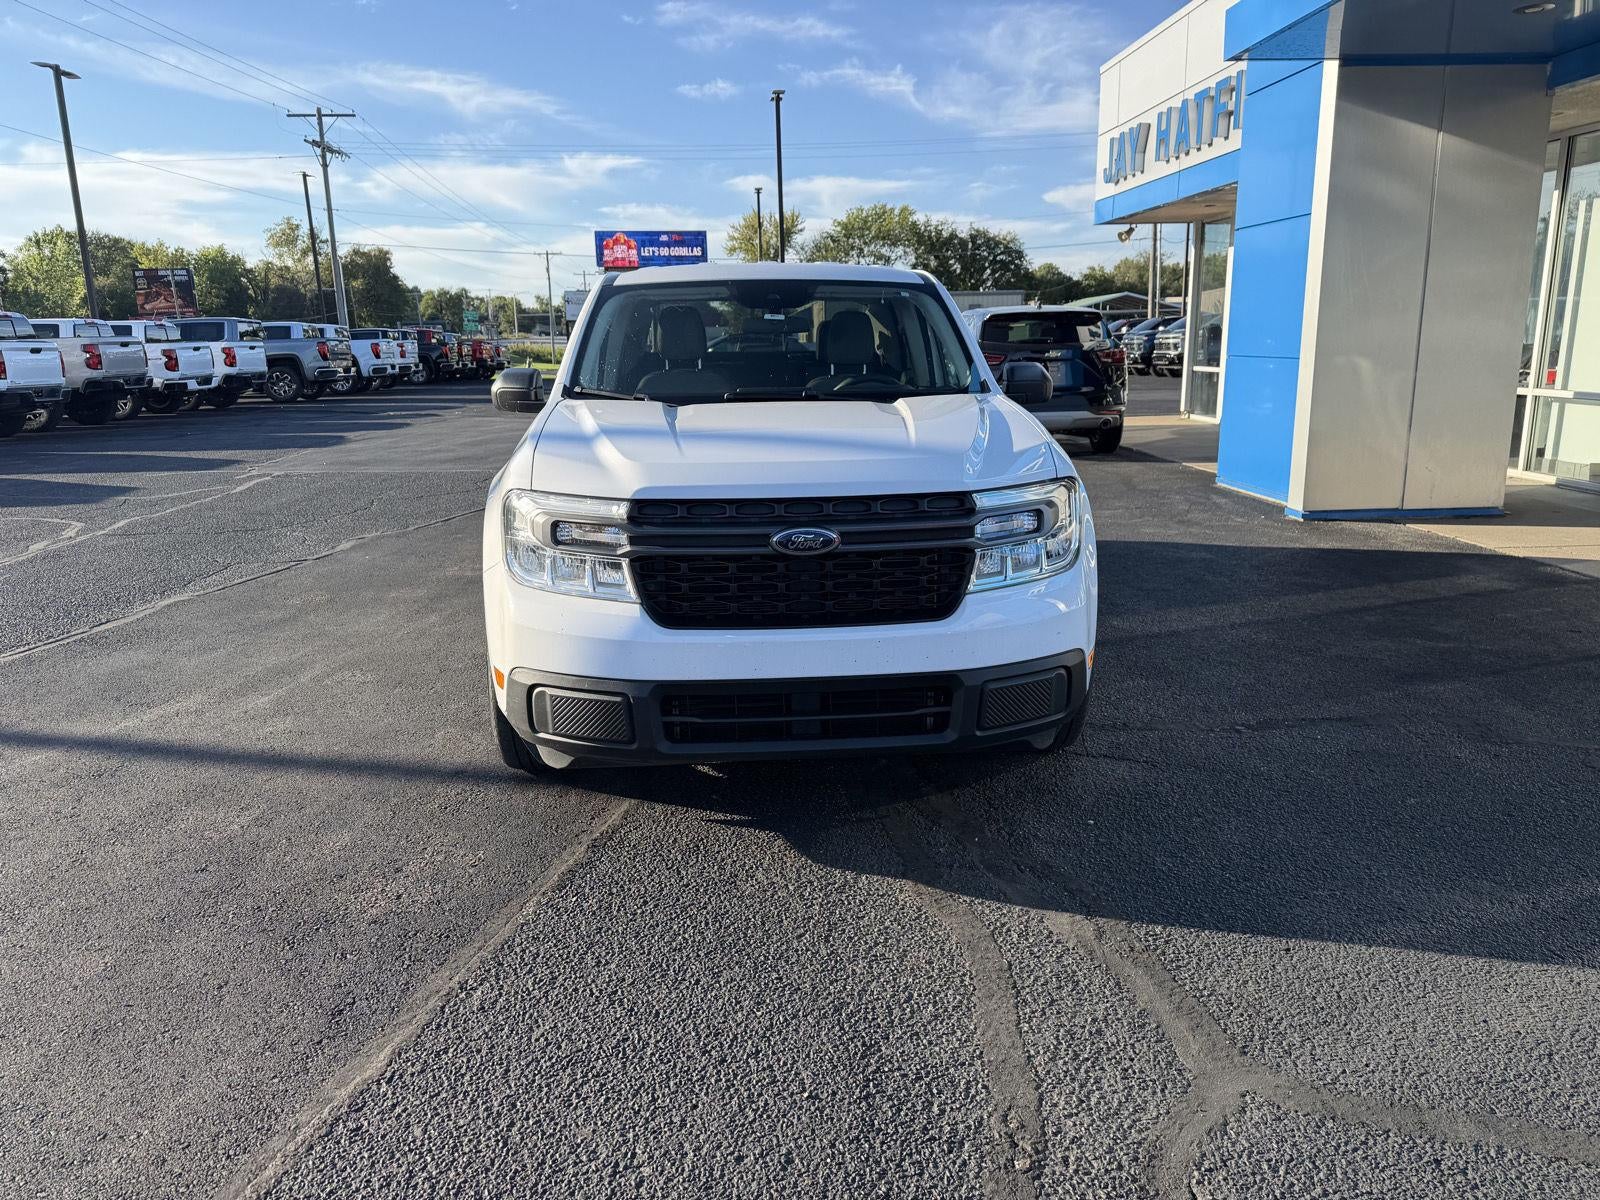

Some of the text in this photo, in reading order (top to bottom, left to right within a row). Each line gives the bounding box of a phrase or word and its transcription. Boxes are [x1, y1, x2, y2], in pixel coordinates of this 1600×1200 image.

[1103, 122, 1147, 184] JAY
[641, 246, 659, 256] LET'S
[660, 246, 670, 256] GO
[670, 246, 702, 256] GORILLAS
[788, 534, 824, 549] Ford
